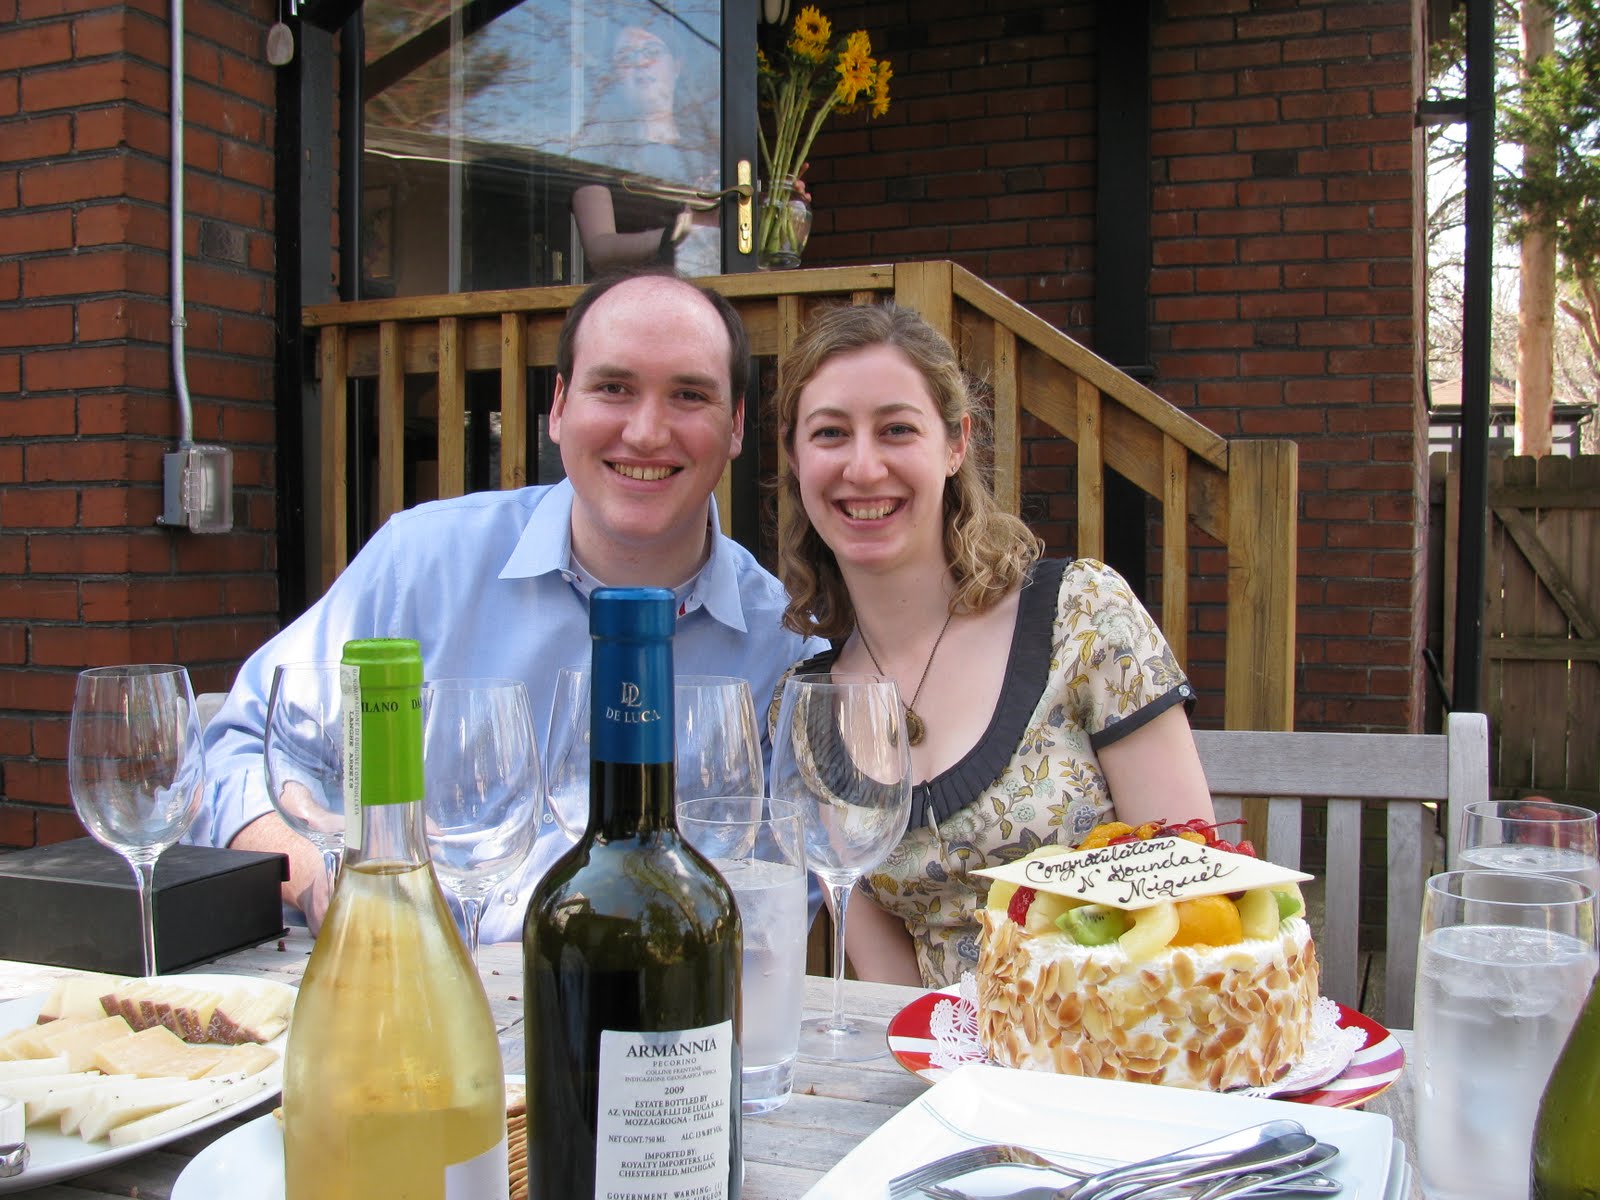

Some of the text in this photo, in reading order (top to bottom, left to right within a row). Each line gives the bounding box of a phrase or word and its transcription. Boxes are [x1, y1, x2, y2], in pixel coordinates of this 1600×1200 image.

[606, 706, 661, 723] DE LUCA
[1026, 840, 1176, 884] Congratulations
[626, 1038, 717, 1058] ARMANNIA
[653, 1058, 697, 1067] PECORINO
[645, 1068, 672, 1076] COLLINE
[666, 1072, 701, 1082] GEOGRAFICA
[664, 1085, 685, 1095] 2009
[635, 1094, 708, 1108] ESTATE BOTTLED BY
[608, 1108, 621, 1117] AZ.
[622, 1109, 662, 1117] VINICOLA
[682, 1106, 692, 1115] DE
[692, 1103, 711, 1113] LUCA
[625, 1116, 688, 1126] MOZZAGROGNA
[693, 1110, 715, 1122] ITALIA
[608, 1134, 622, 1143] NET
[623, 1135, 645, 1144] CONT.
[645, 1136, 656, 1144] 750
[656, 1135, 666, 1143] ML
[621, 1160, 658, 1169] ROYALTY
[703, 1153, 715, 1162] LLC
[645, 1151, 686, 1160] IMPORTED
[619, 1161, 716, 1178] CHESTERFIELD, MICHIGAN
[607, 1192, 669, 1200] GOVERNMENT
